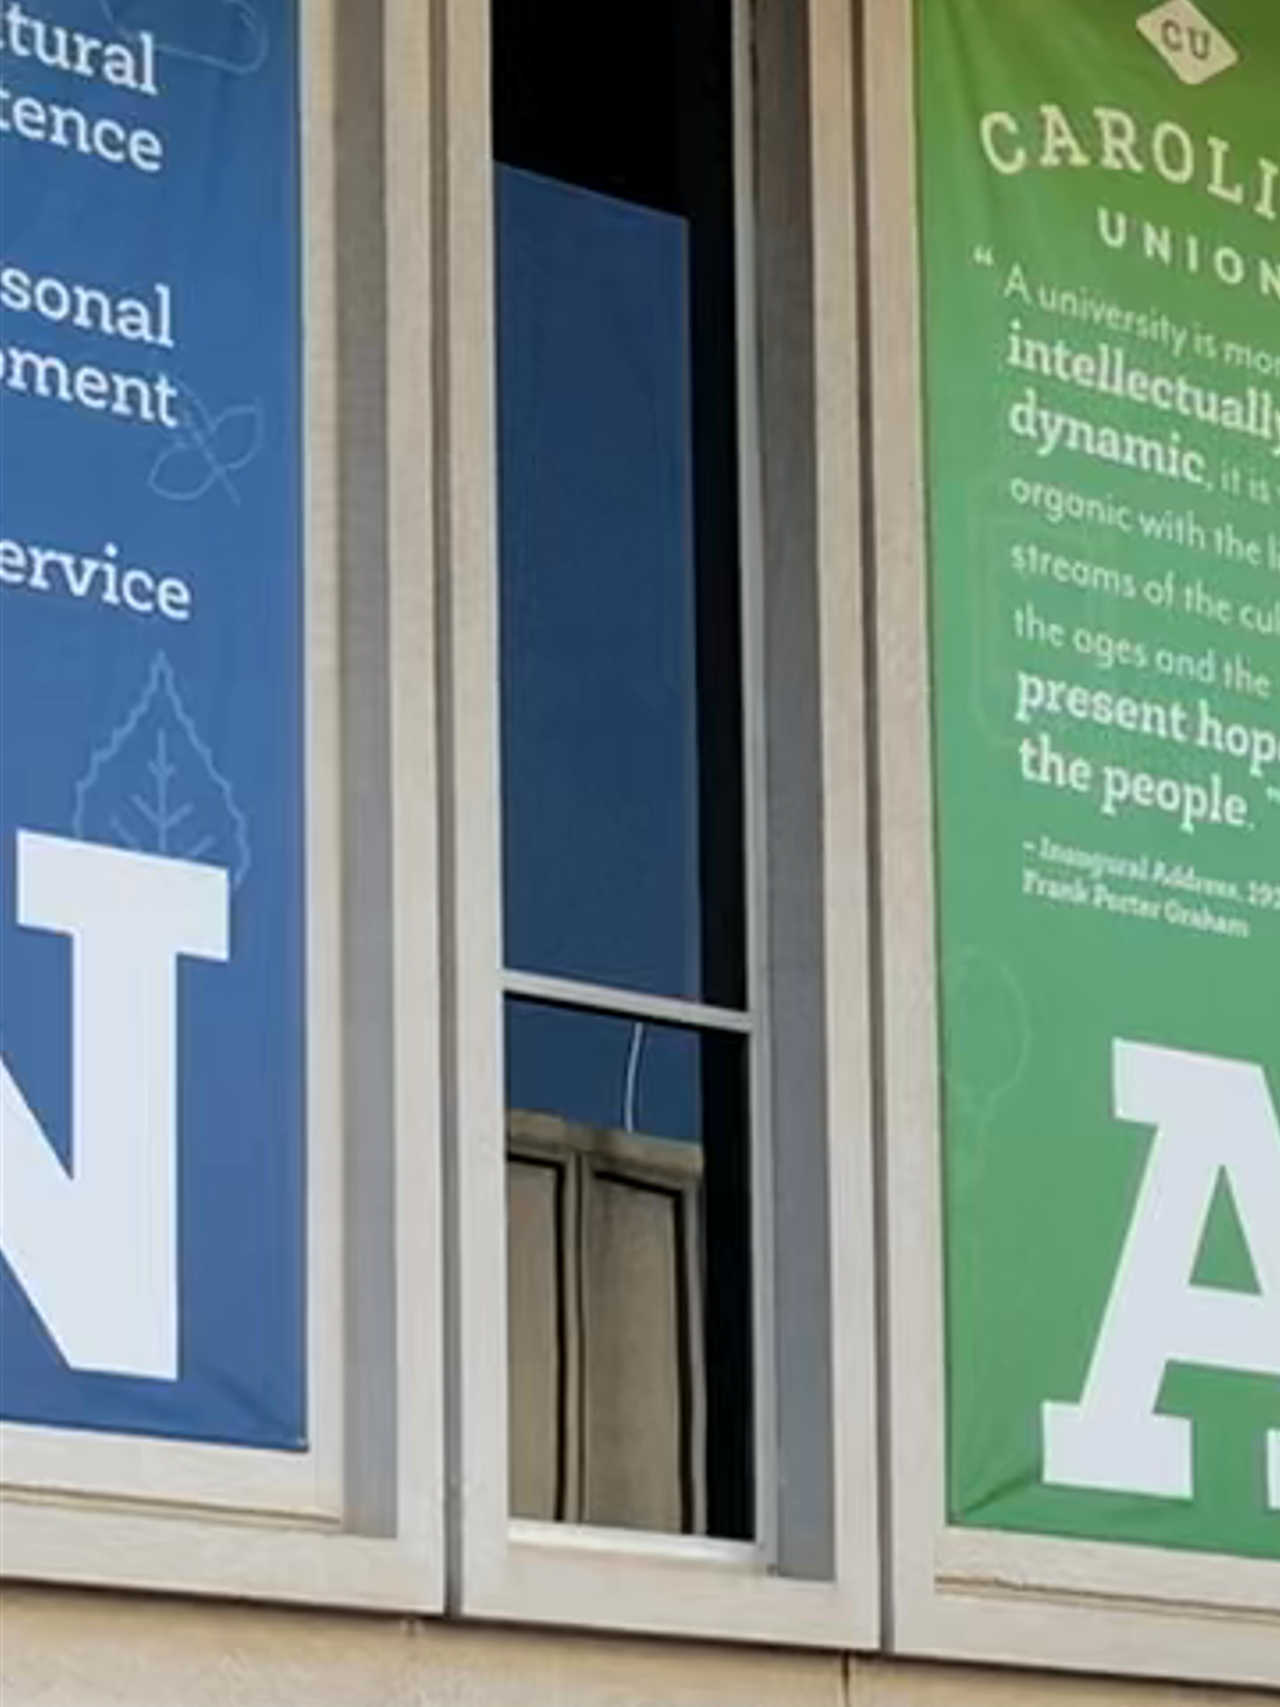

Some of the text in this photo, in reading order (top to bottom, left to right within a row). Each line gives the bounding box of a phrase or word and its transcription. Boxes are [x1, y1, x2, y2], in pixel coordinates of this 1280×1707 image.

[1160, 20, 1211, 61] CU
[1038, 287, 1188, 357] university
[1193, 322, 1216, 358] is
[0, 346, 178, 428] ment
[1009, 389, 1213, 491] dynamic,
[1222, 461, 1241, 496] it
[1248, 474, 1271, 505] is
[1010, 477, 1134, 532] organic
[1138, 509, 1206, 551] with
[1214, 524, 1262, 566] the
[1010, 543, 1136, 598] streams
[1143, 571, 1175, 608] of
[1183, 580, 1232, 624] the
[1013, 601, 1272, 699] the ages and the
[1015, 670, 1188, 743] present
[1019, 733, 1093, 793] the
[1022, 868, 1251, 938] Frank Porter Graham
